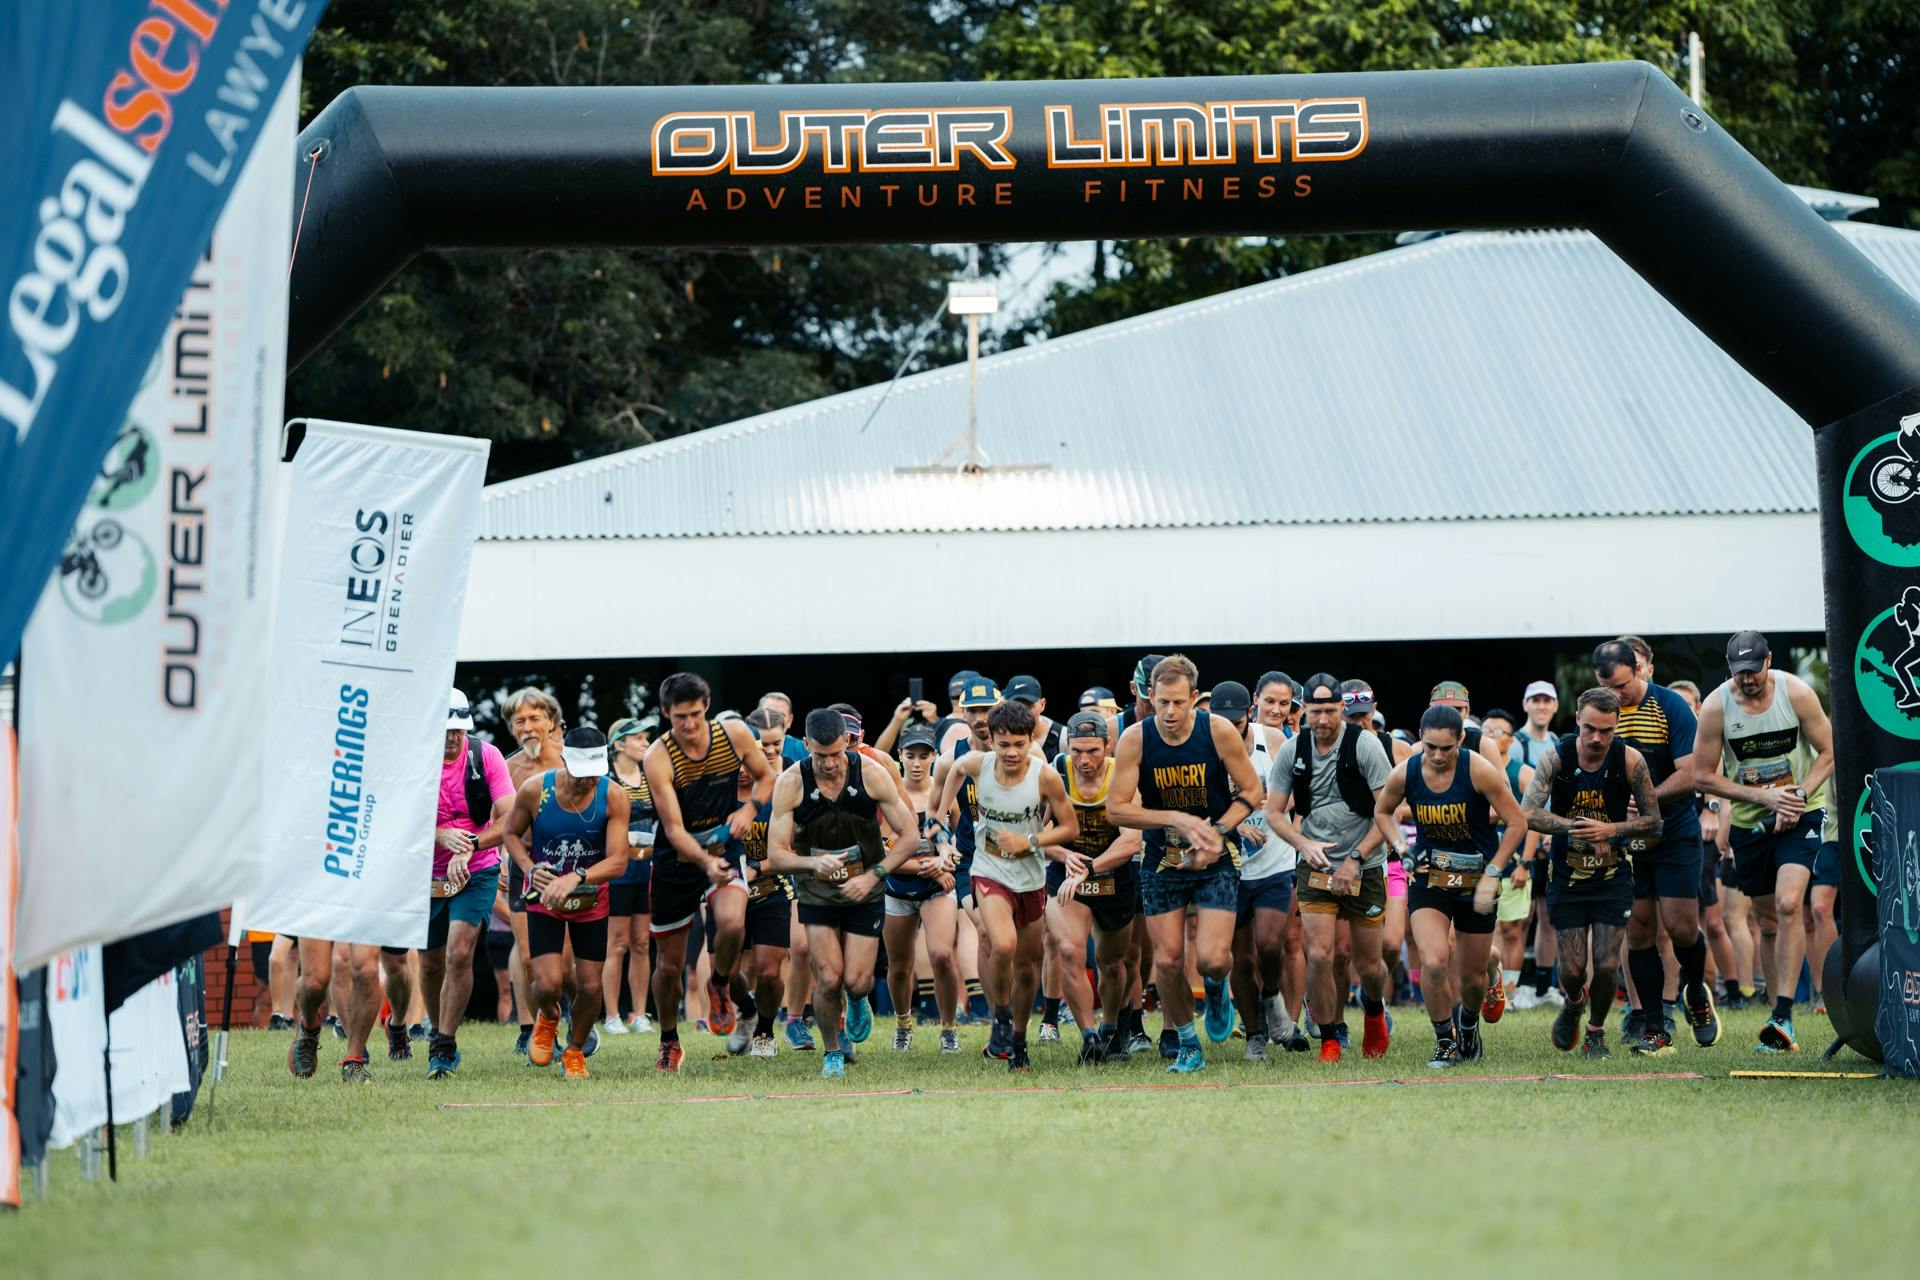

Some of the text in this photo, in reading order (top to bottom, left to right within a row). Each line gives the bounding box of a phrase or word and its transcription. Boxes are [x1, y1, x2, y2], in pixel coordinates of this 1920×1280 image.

[651, 105, 1018, 177] OUTER
[686, 174, 1313, 211] ADVENTURE FITNESS
[164, 467, 208, 710] OUTER
[340, 508, 389, 648] INEOS
[1153, 763, 1207, 789] HUNGRY
[1416, 802, 1467, 825] HUNGRY
[352, 794, 377, 879] Auto Group
[1630, 839, 1646, 850] 65
[443, 882, 458, 895] 98
[1080, 882, 1100, 894] 128
[1447, 874, 1463, 886] 24
[564, 898, 581, 910] 49
